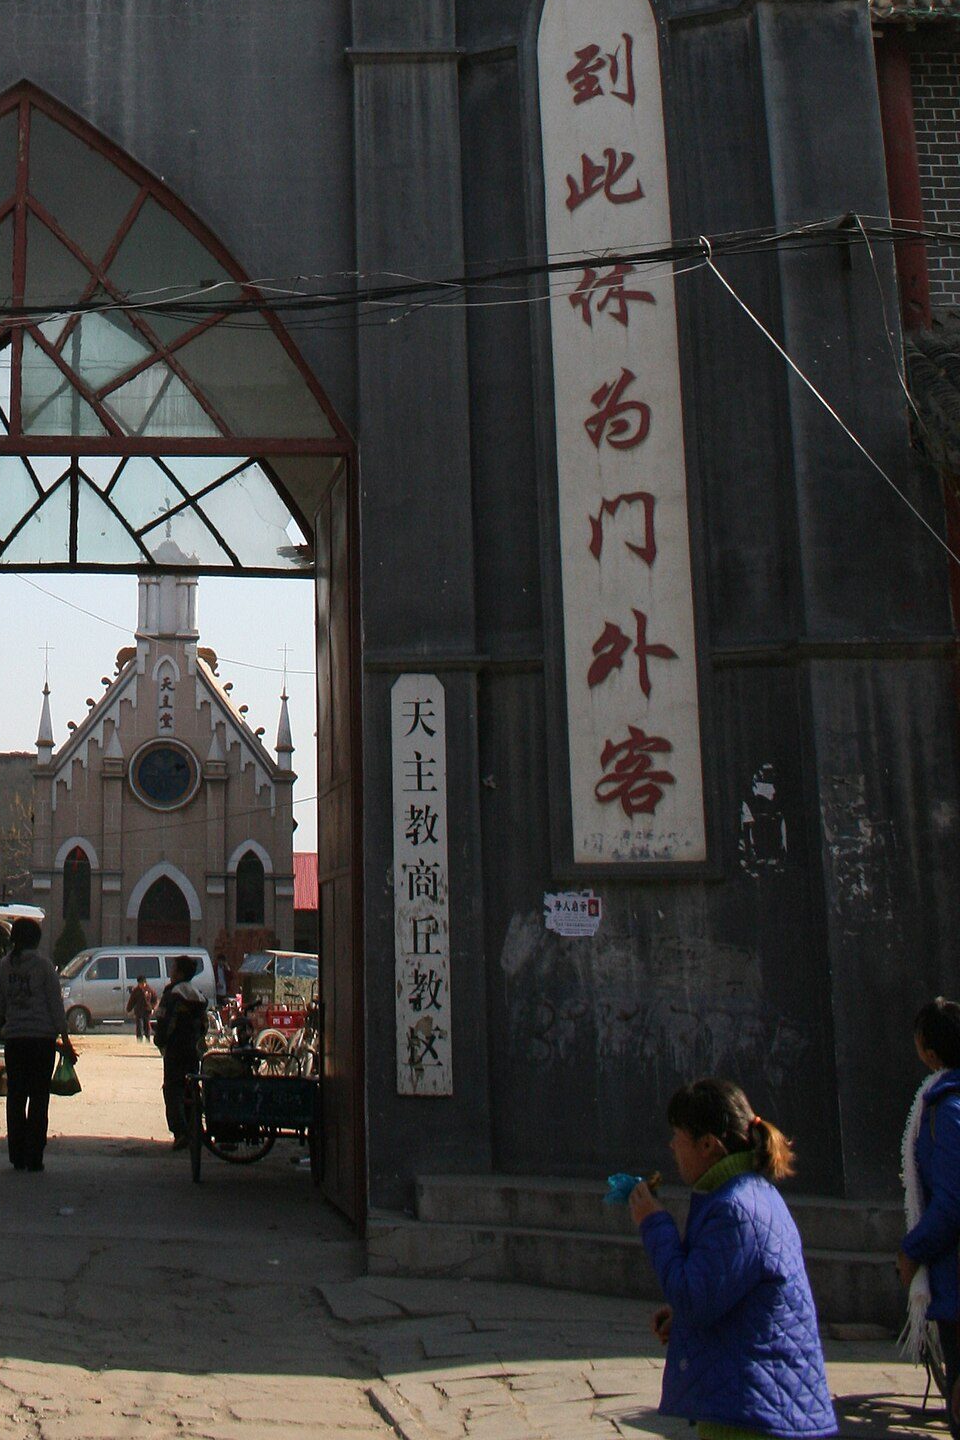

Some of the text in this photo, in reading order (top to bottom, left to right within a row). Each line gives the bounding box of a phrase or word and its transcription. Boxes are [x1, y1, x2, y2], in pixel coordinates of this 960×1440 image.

[564, 33, 680, 819] 到此休为门外客
[159, 676, 176, 729] 天主堂
[401, 696, 444, 1067] 天主教商丘教区
